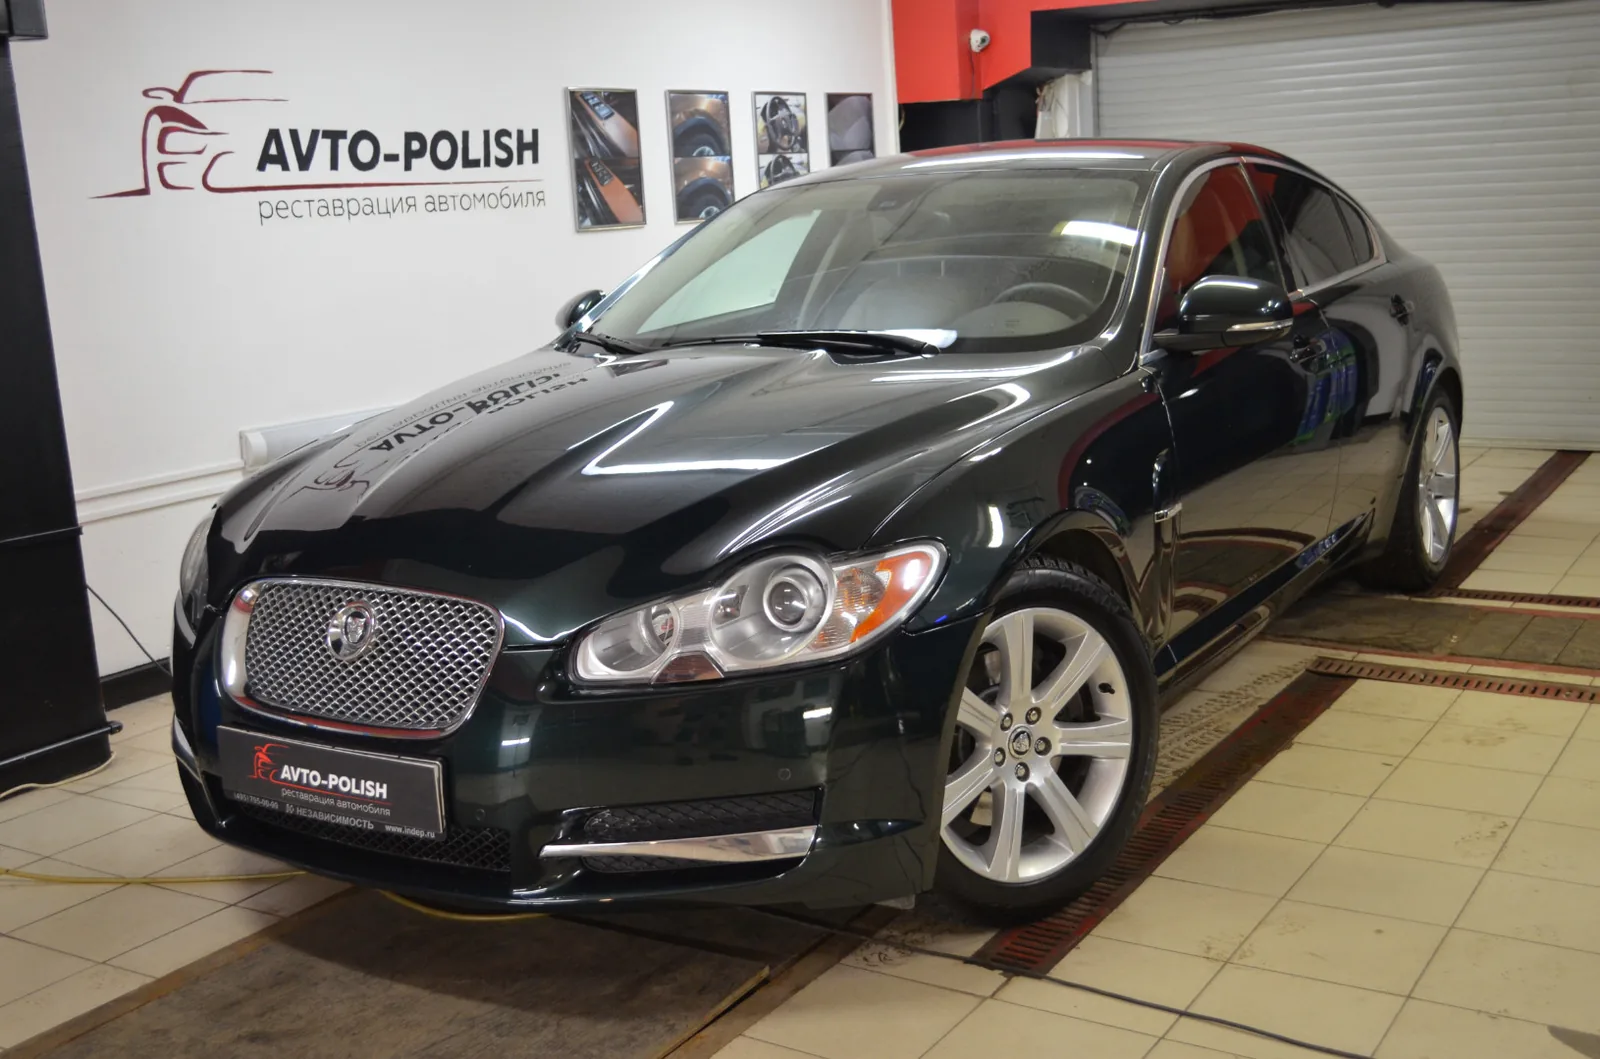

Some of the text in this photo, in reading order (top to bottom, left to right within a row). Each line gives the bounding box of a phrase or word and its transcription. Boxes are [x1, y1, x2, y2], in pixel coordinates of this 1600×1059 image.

[256, 128, 540, 172] AVTO-POLISH
[257, 187, 546, 226] реставрация автомобиля
[280, 764, 388, 799] AVTO-POLISH
[281, 788, 391, 816] реставрация автомобиля
[296, 806, 375, 830] НЕЗАВИСИМОСТЬ
[384, 824, 436, 839] www.indep.ru
